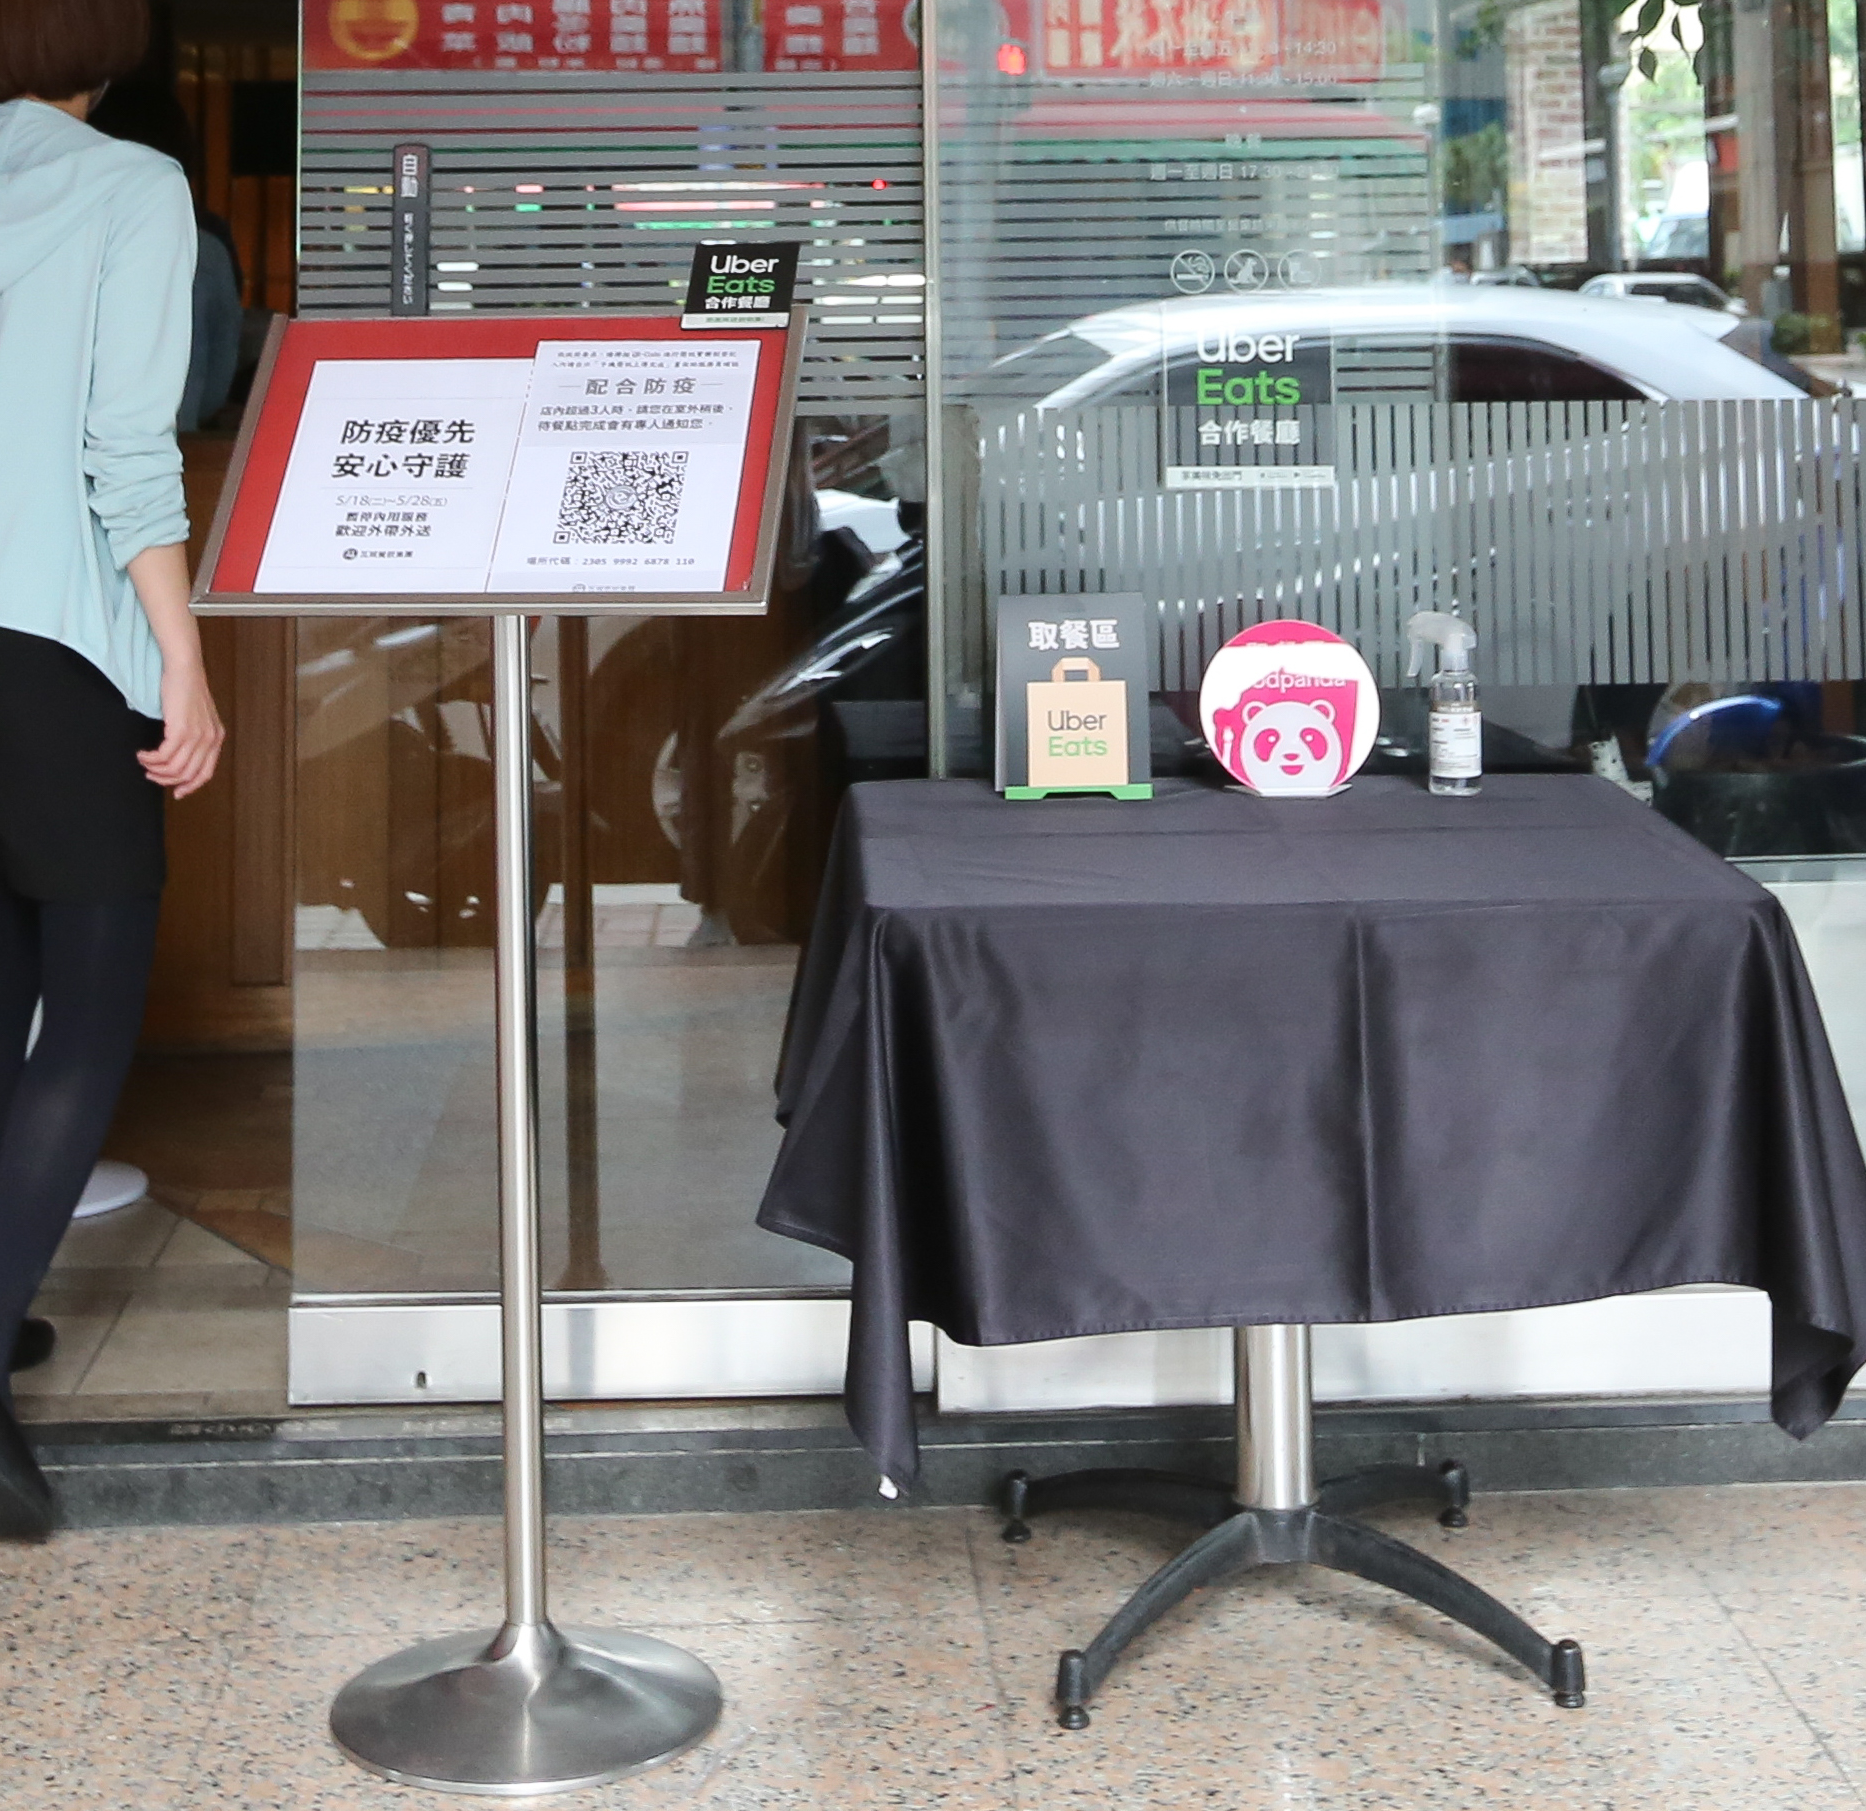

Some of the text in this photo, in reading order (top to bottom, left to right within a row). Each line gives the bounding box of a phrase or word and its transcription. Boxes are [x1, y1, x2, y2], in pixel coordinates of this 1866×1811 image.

[710, 254, 780, 274] Uber
[706, 275, 775, 294] Eats
[704, 295, 771, 309] 合作餐廳
[1196, 329, 1301, 363] Uber
[585, 377, 697, 396] 配合防疫
[1196, 367, 1301, 405] Eats
[340, 419, 476, 445] 防疫優先
[1197, 418, 1301, 446] 合作餐廳
[331, 453, 471, 479] 安心守護
[335, 524, 432, 537] 歡迎外帶外送
[1027, 619, 1121, 651] 取餐區
[1047, 710, 1108, 732] Uber
[1048, 735, 1108, 757] Eats
